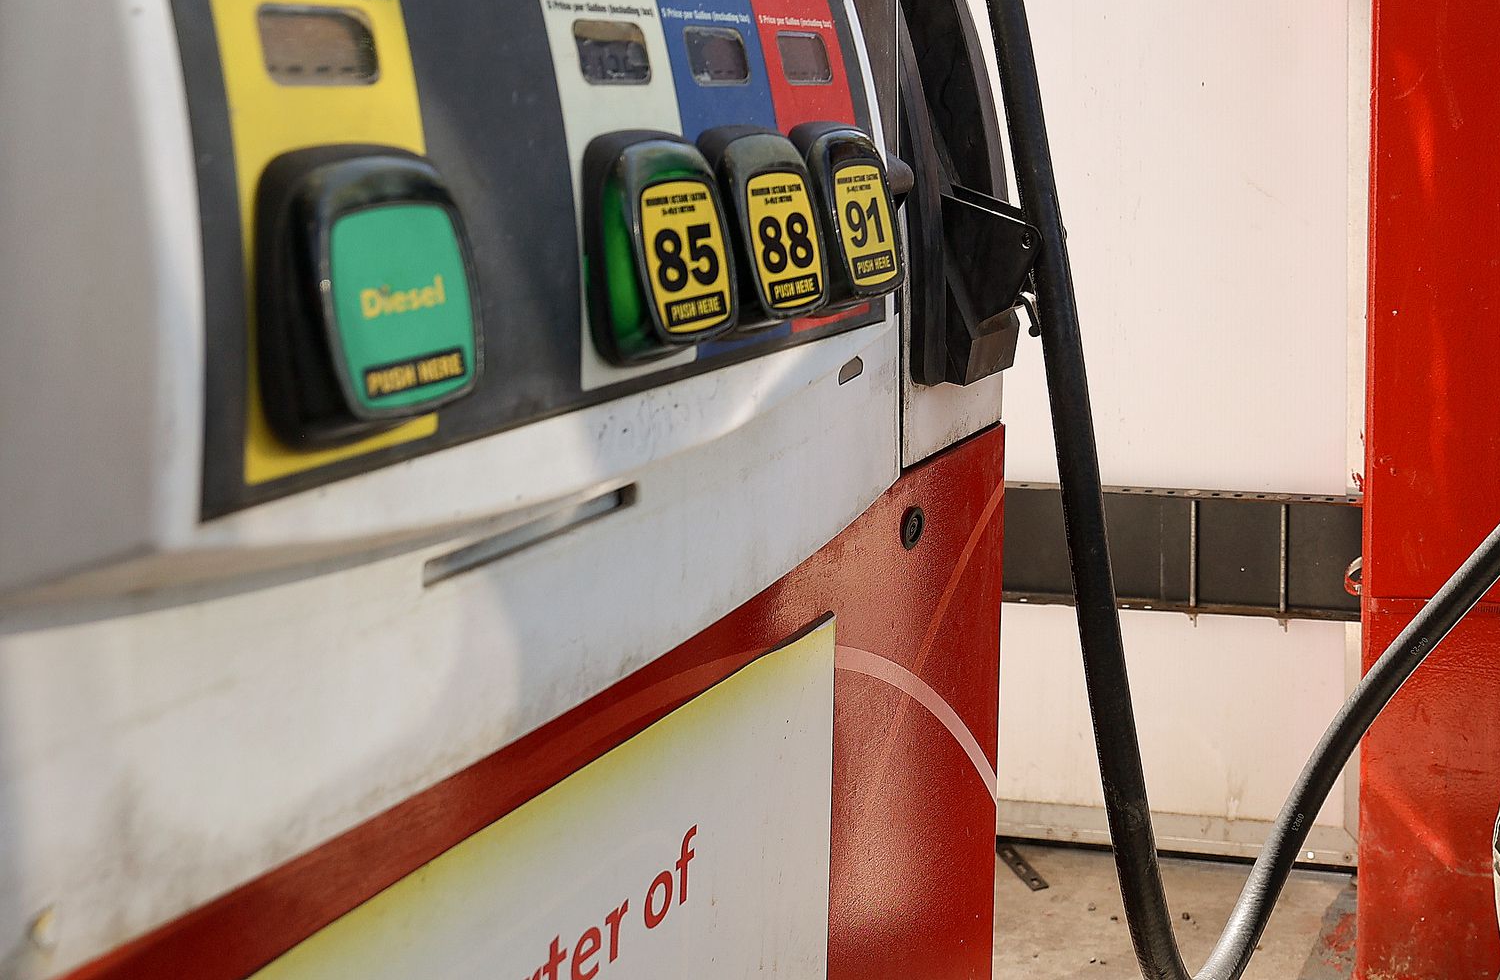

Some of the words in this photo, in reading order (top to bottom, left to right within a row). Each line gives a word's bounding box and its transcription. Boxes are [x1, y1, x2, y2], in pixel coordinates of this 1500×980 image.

[758, 212, 814, 273] 88
[845, 197, 885, 248] 91
[655, 223, 719, 292] 85
[857, 258, 875, 275] PUSH
[874, 253, 892, 270] HERE
[360, 273, 445, 318] Diesel
[671, 301, 696, 322] PUSH
[696, 296, 721, 316] HERE
[774, 283, 795, 300] PUSH
[795, 276, 816, 294] HERE
[1291, 813, 1305, 832] 0923
[524, 898, 630, 980] ter
[643, 823, 698, 929] of
